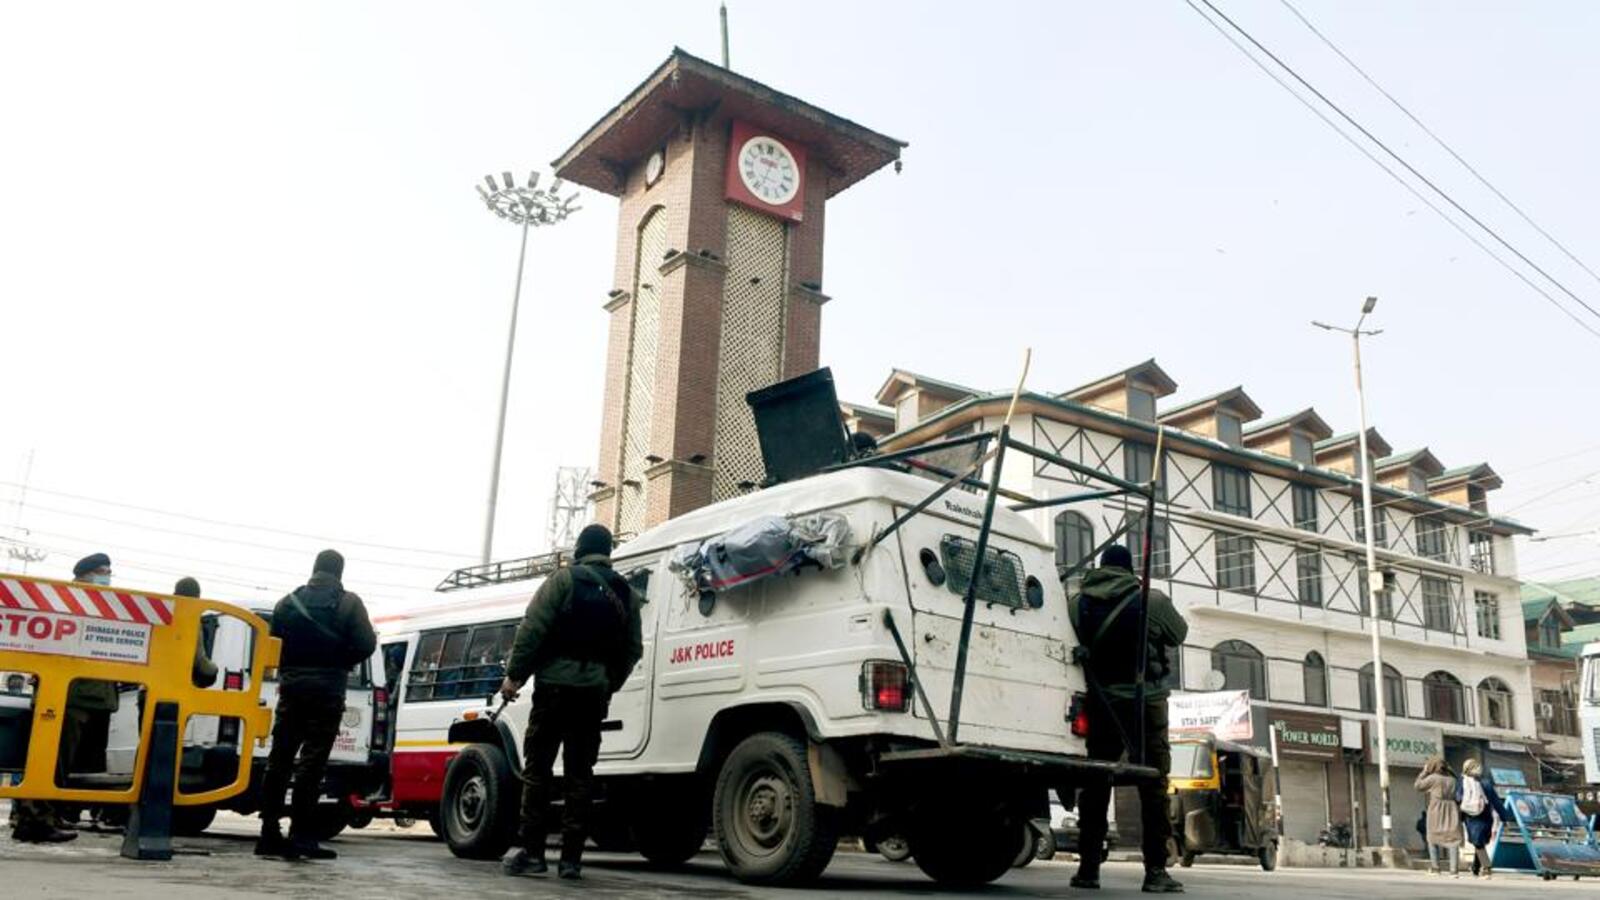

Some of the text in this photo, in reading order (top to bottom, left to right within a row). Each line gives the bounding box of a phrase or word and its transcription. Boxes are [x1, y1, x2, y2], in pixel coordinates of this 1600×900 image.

[0, 613, 77, 640] TOP
[121, 629, 146, 638] POLICE
[670, 640, 735, 664] J&K POLICE
[1181, 717, 1198, 726] STAY
[1282, 731, 1340, 747] POWER WORLD
